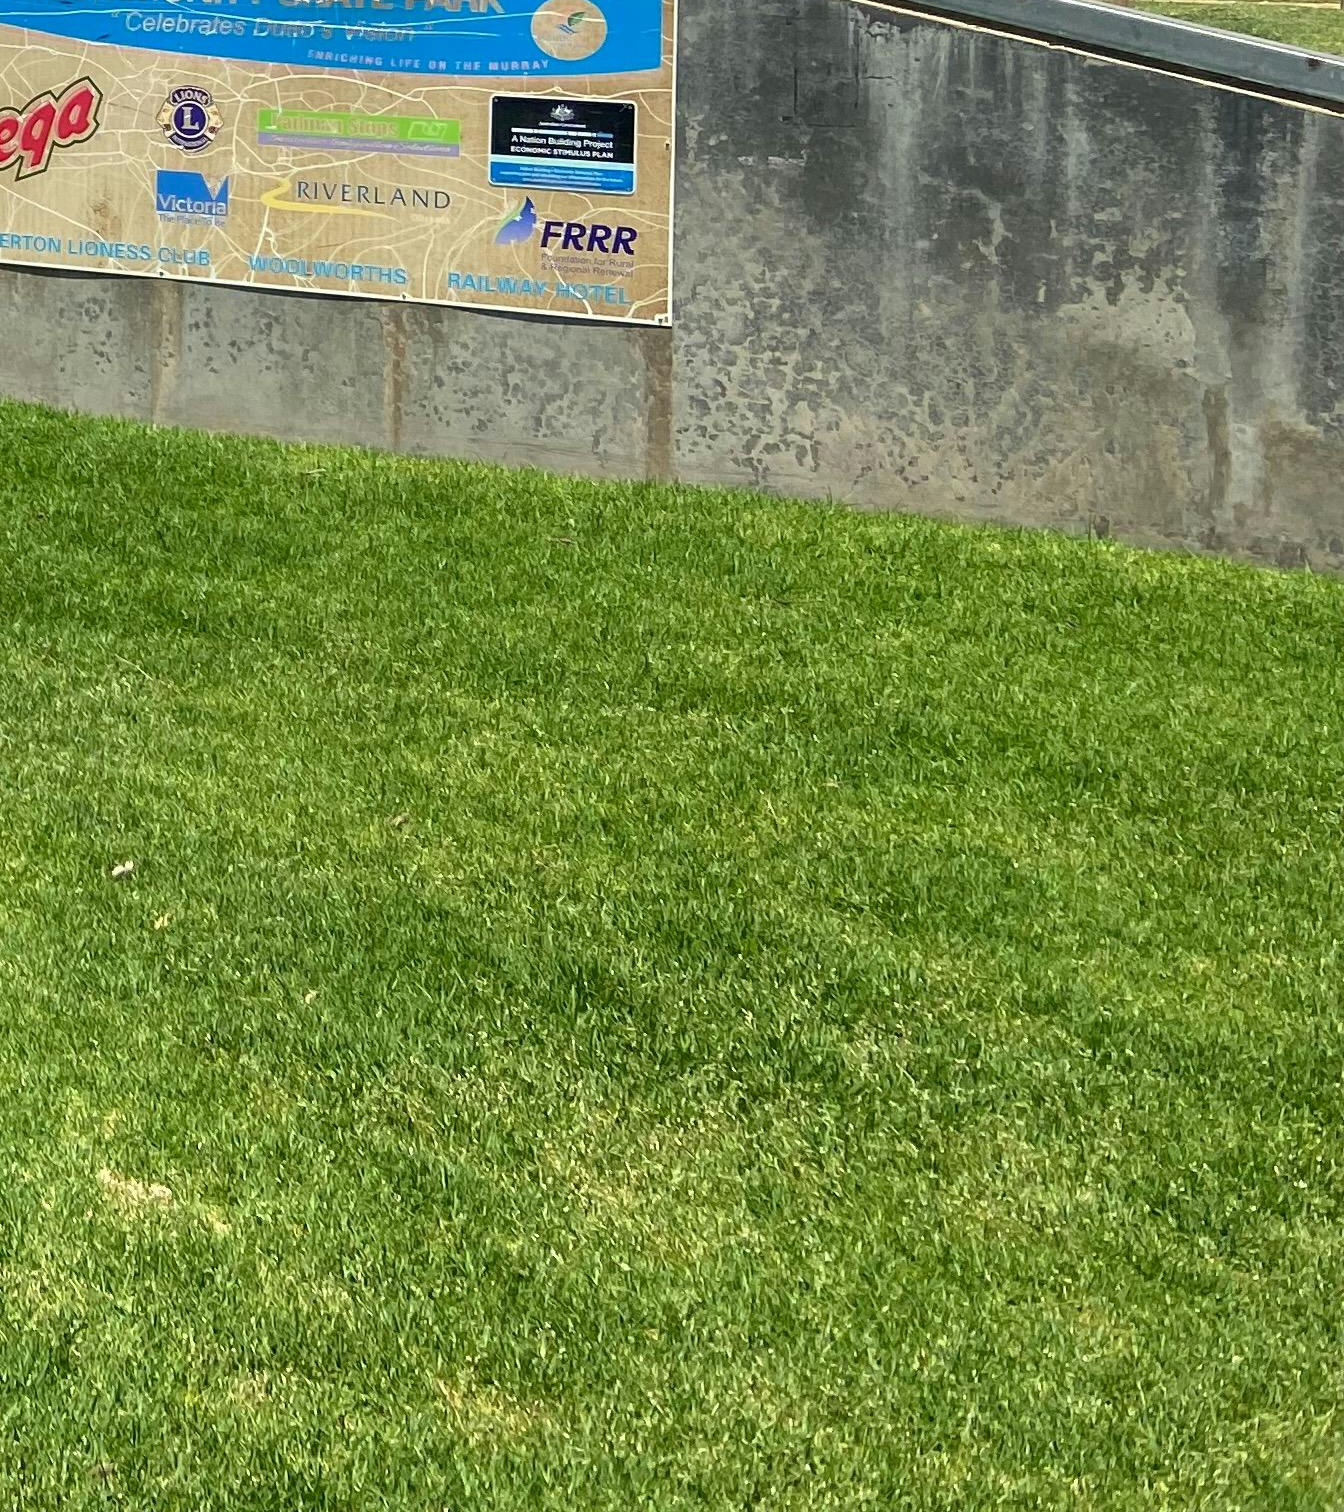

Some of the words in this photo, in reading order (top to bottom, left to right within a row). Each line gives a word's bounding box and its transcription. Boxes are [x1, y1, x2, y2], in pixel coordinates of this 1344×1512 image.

[308, 49, 383, 67] ENRICHING
[390, 58, 420, 70] LIFE
[428, 59, 447, 71] ON
[455, 60, 481, 71] THE
[488, 59, 549, 72] MURRAY
[173, 88, 209, 107] LIONS
[181, 106, 200, 131] L
[510, 145, 552, 155] ECONOMIC
[553, 148, 591, 158] STIMULUS
[592, 151, 614, 159] PLAN
[511, 134, 519, 143] A
[519, 135, 547, 145] Nation
[548, 137, 582, 148] Building
[583, 140, 614, 150] Project
[157, 193, 227, 215] Victoria
[297, 181, 451, 209] RIVERLAND
[540, 220, 638, 256] FRRR
[67, 240, 151, 262] LIONESS
[158, 246, 210, 266] CLUB
[541, 253, 592, 266] Foundation
[593, 257, 607, 266] for
[609, 259, 635, 268] Rural
[248, 255, 407, 285] WOOLWORTHS
[549, 263, 590, 276] Regional
[592, 268, 634, 278] Renewal
[447, 272, 548, 297] RAILWAY
[556, 281, 632, 305] HOTEL
